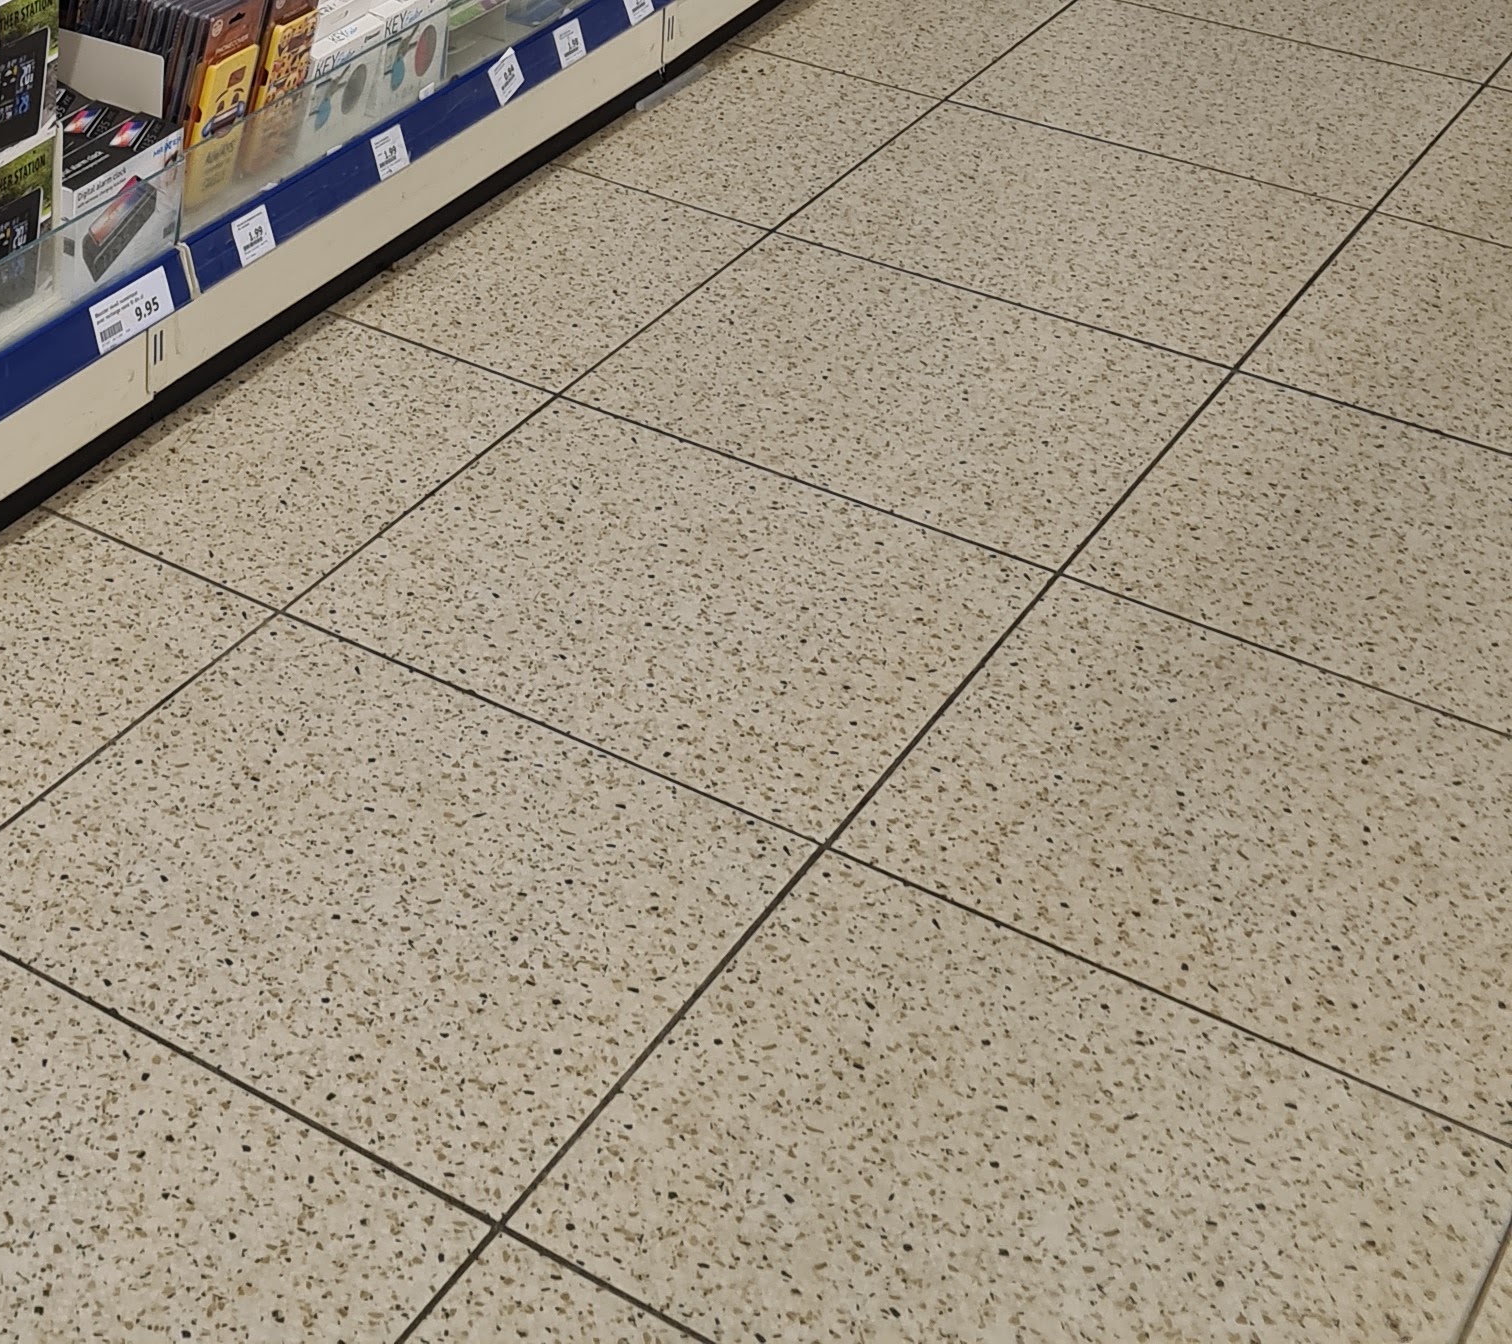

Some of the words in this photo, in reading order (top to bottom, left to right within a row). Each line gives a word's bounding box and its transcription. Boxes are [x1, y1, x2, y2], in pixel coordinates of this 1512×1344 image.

[384, 11, 408, 37] KEY
[314, 54, 341, 80] KEY
[12, 153, 46, 188] STATION
[135, 296, 160, 322] 9.95
